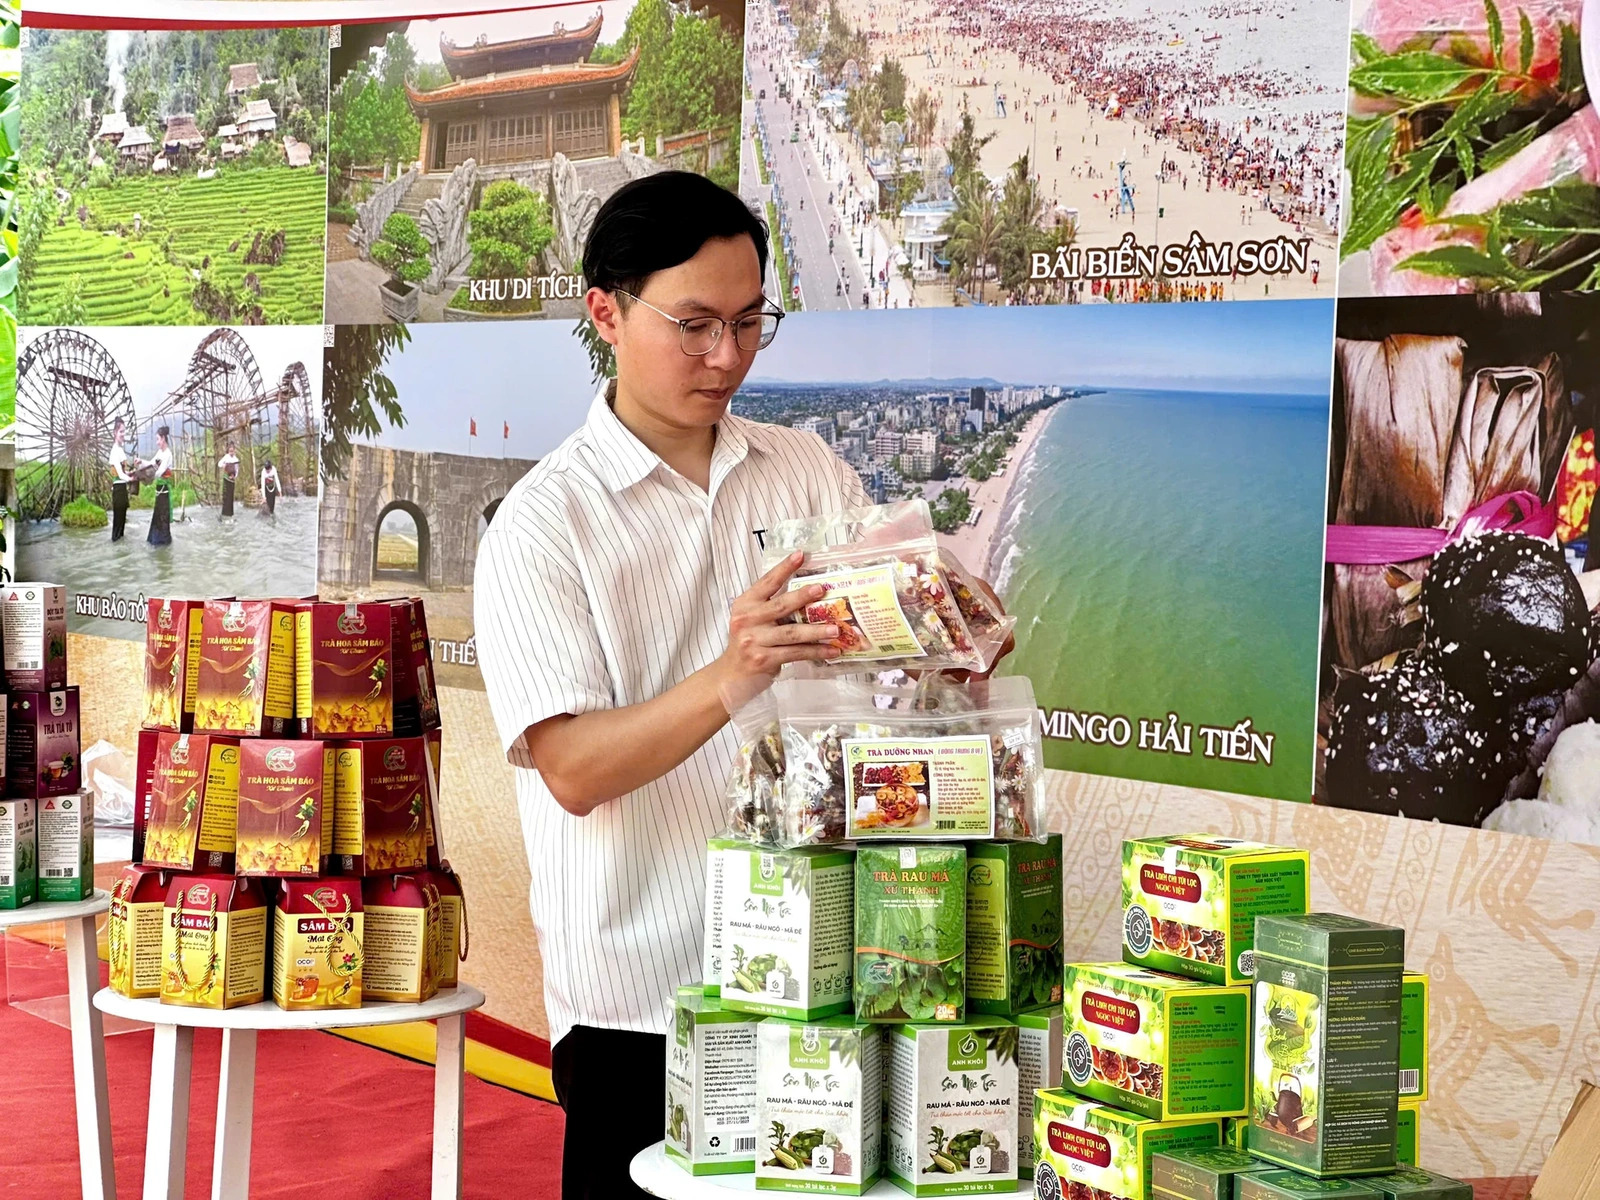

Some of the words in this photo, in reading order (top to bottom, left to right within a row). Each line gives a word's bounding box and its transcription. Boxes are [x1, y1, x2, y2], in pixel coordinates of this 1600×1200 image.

[1030, 246, 1080, 280] BÃI
[1086, 234, 1157, 278] BIỂN
[1163, 231, 1232, 275] SẦM
[1237, 237, 1310, 273] SƠN
[469, 279, 508, 301] KHU
[512, 276, 532, 299] DI
[537, 269, 582, 298] TÍCH
[752, 529, 769, 552] T
[76, 595, 99, 616] KHU
[101, 592, 126, 619] BẢO
[320, 638, 335, 648] TRÀ
[336, 640, 352, 648] HOA
[352, 638, 368, 647] SÂM
[369, 638, 384, 647] BÁO
[1138, 713, 1192, 754] HẢI
[1199, 719, 1274, 765] TIẾN
[867, 748, 882, 757] TRÀ
[884, 746, 911, 757] DƯỠNG
[912, 748, 934, 756] NHAN
[247, 775, 262, 784] TRÀ
[263, 776, 279, 785] HOA
[280, 775, 297, 785] SÂM
[298, 775, 314, 785] BÁO
[873, 868, 898, 882] TRÀ
[901, 871, 928, 882] RAU
[931, 869, 950, 882] MÁ
[1143, 869, 1154, 879] TRÀ
[1155, 872, 1167, 882] LINH
[1168, 874, 1177, 883] CHI
[1178, 875, 1187, 885] TÚI
[1187, 878, 1197, 888] LỌC
[883, 885, 898, 895] XỨ
[901, 886, 939, 895] THANH
[1155, 883, 1172, 893] NGỌC
[1172, 886, 1186, 896] VIỆT
[300, 920, 325, 931] SÂM
[327, 919, 351, 931] BO
[755, 923, 768, 931] RÂU
[1085, 997, 1096, 1007] TRÀ
[1096, 1000, 1107, 1010] LINH
[1108, 1003, 1117, 1013] CHI
[1117, 1004, 1126, 1016] TÚI
[1126, 1009, 1136, 1019] LỌC
[1095, 1011, 1112, 1022] NGỌC
[1112, 1015, 1125, 1026] VIỆT
[812, 1098, 827, 1106] NGÔ
[844, 1101, 854, 1109] ĐỀ
[941, 1101, 951, 1109] MÁ
[956, 1100, 970, 1108] RÂU
[970, 1099, 985, 1107] NGÔ
[989, 1098, 1000, 1106] MÃ
[1051, 1127, 1062, 1138] TRÀ
[1062, 1131, 1074, 1141] LINH
[1075, 1134, 1085, 1145] CHI
[1086, 1136, 1095, 1148] TÚI
[1095, 1142, 1106, 1152] LỌC
[1062, 1142, 1079, 1154] NGỌC
[1079, 1146, 1094, 1159] VIỆT
